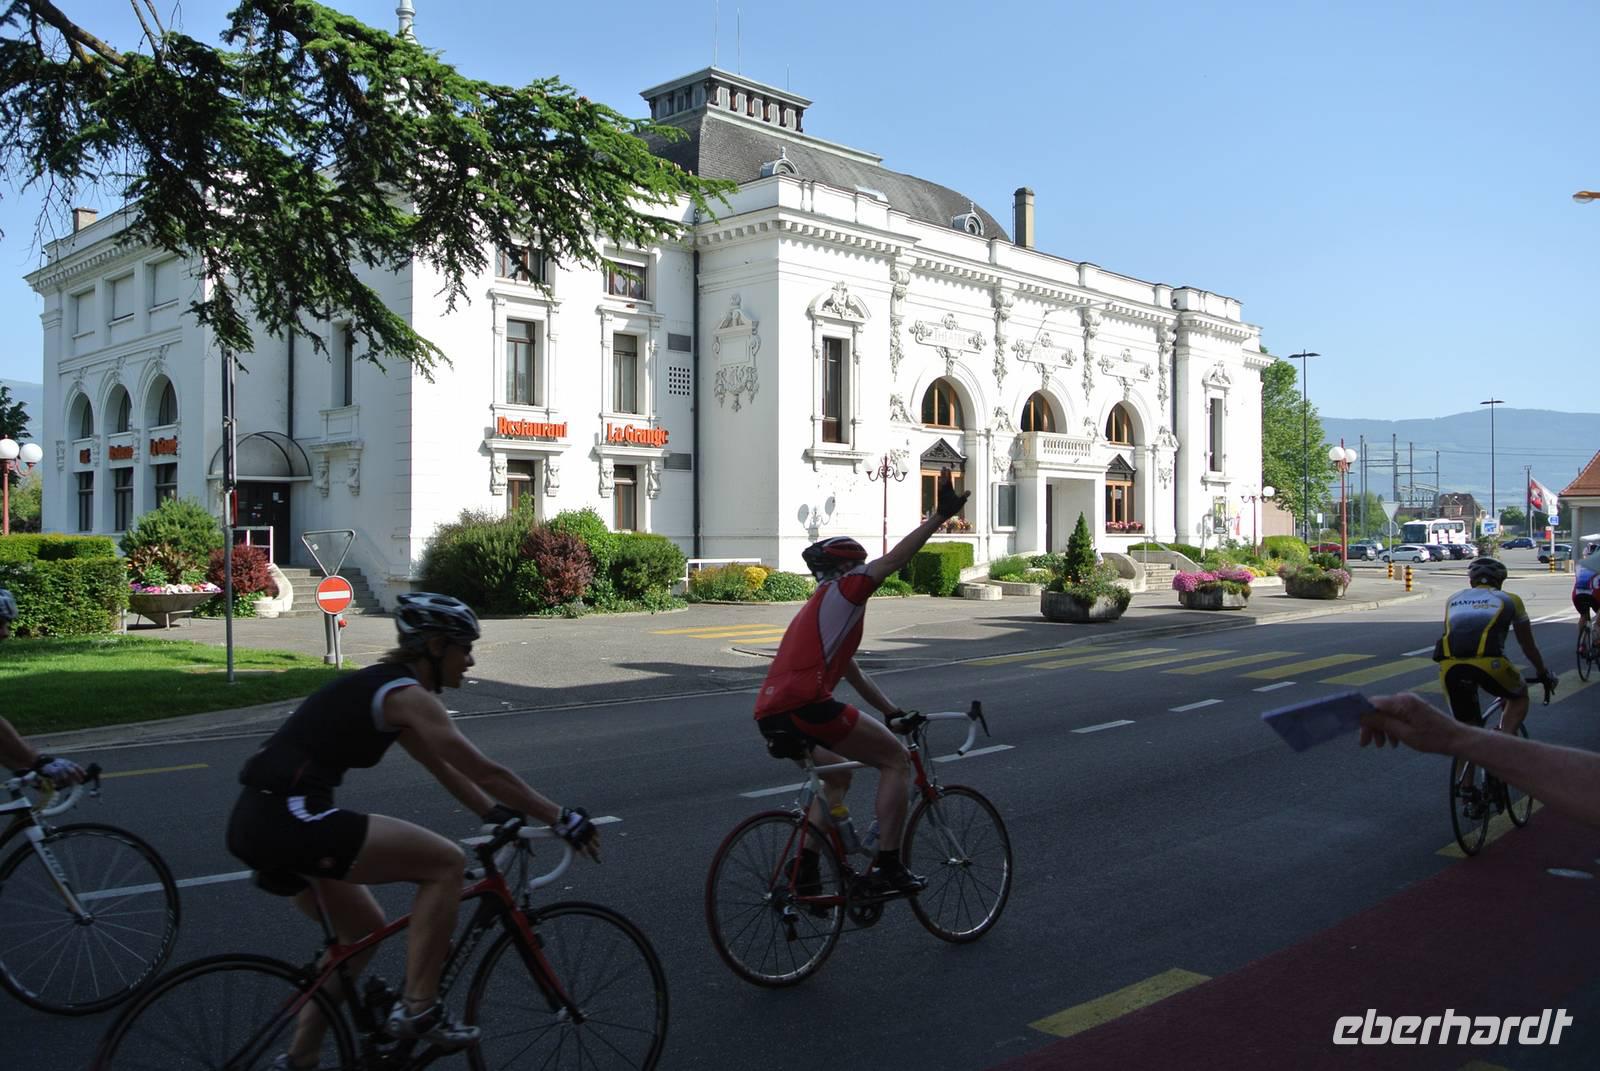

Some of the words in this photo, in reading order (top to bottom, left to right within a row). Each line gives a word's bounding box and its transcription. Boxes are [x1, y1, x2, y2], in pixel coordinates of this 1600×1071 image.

[497, 416, 567, 438] Restaurant
[607, 423, 623, 442] La
[624, 424, 669, 447] Grange
